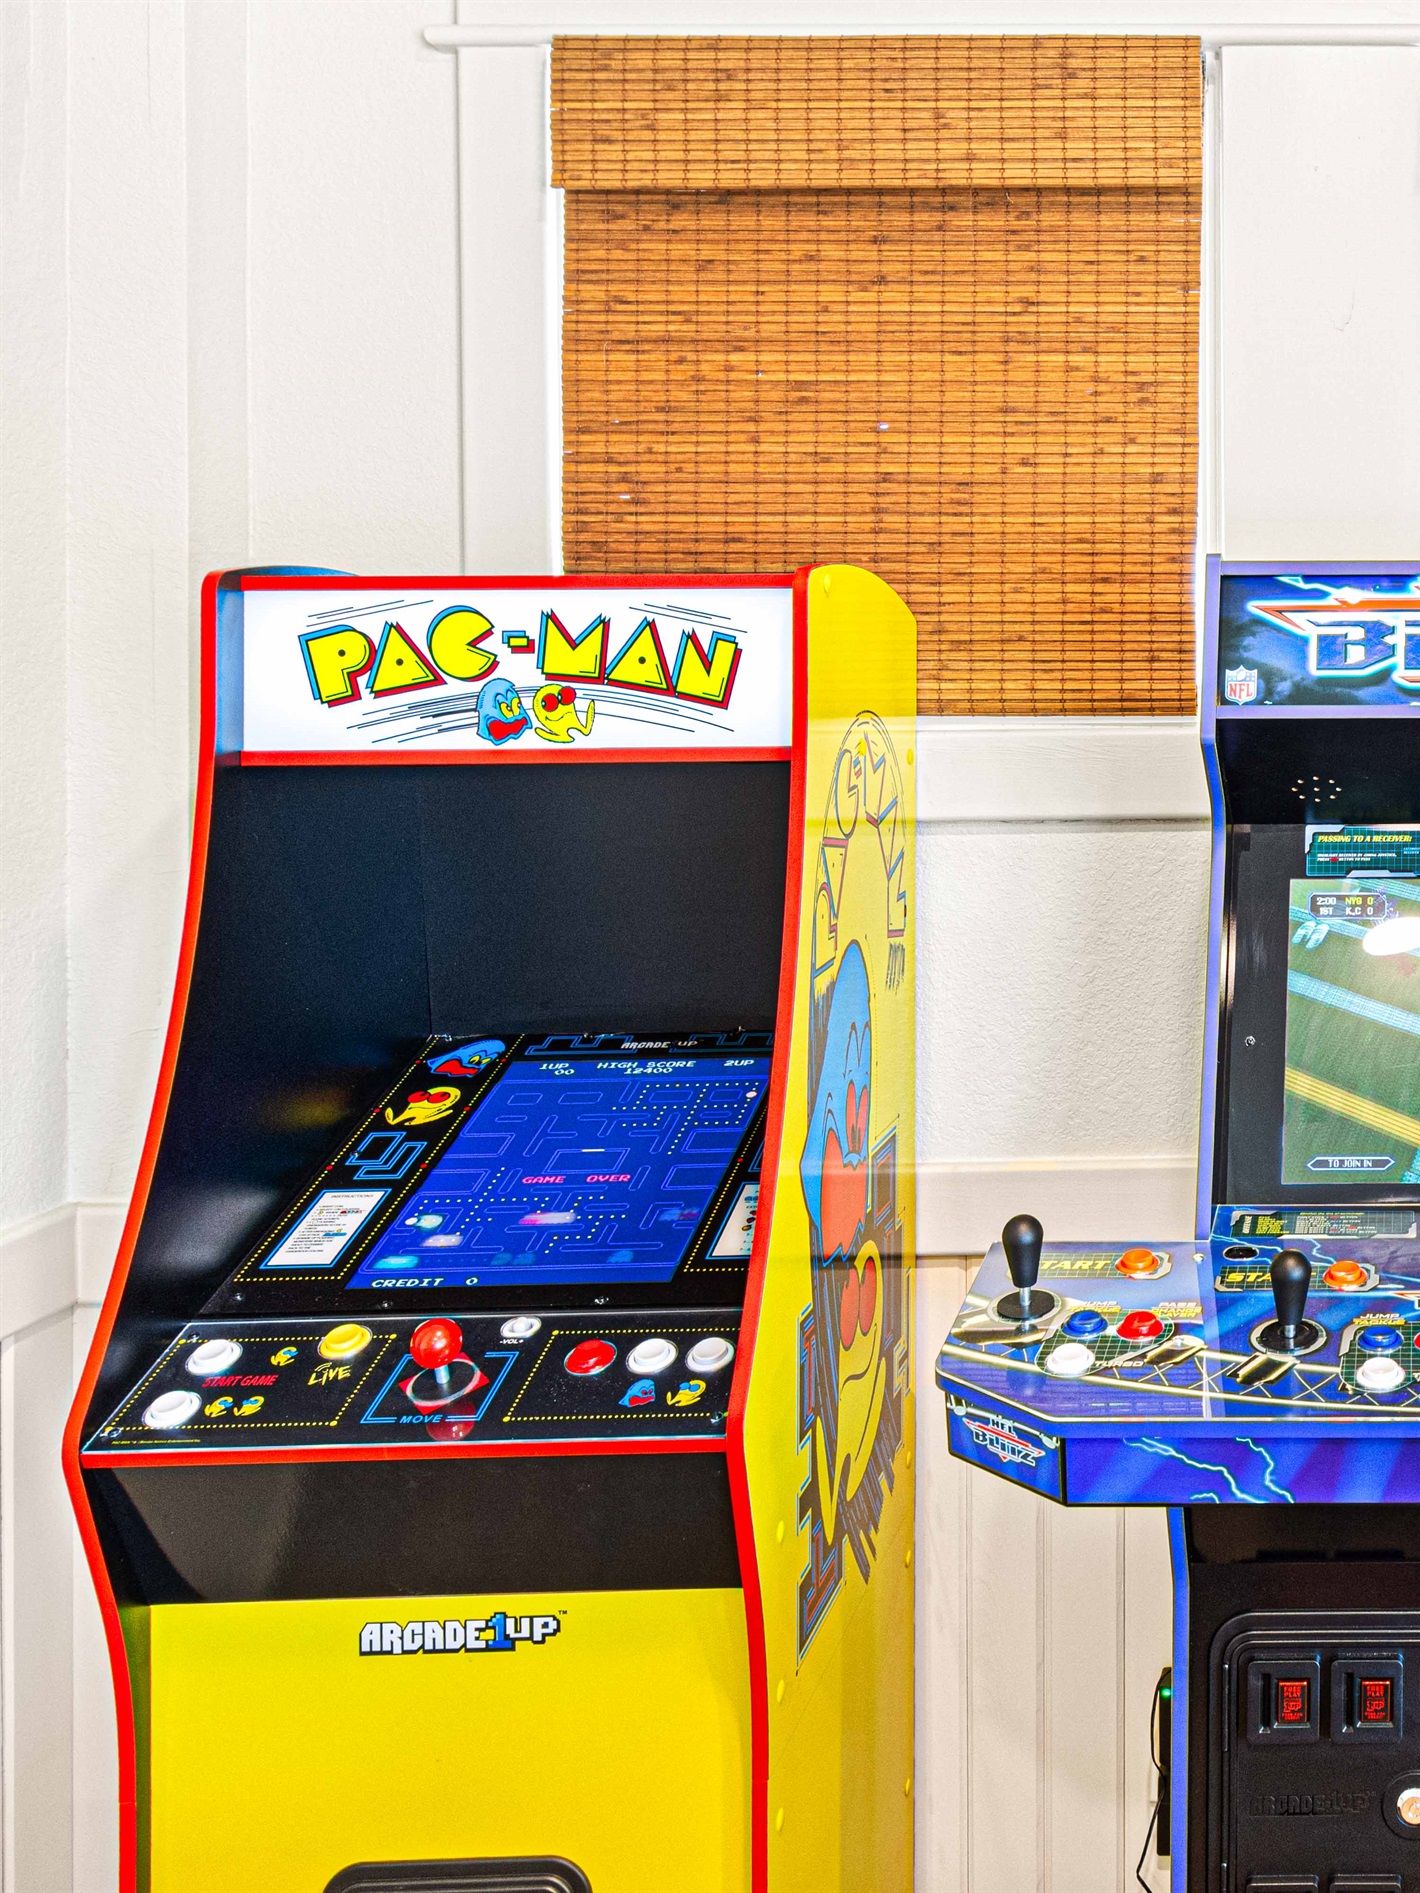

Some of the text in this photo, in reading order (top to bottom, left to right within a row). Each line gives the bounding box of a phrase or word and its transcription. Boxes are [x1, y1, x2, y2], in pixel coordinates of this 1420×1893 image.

[298, 605, 743, 709] PAC-MAN
[1228, 683, 1253, 700] NFL
[1316, 897, 1336, 905] 2:00
[1367, 897, 1374, 905] 0
[1320, 907, 1334, 915] 1ST
[1367, 907, 1374, 915] 0
[539, 1062, 569, 1070] 1UP
[646, 1060, 696, 1068] SCORE
[1328, 1159, 1372, 1168] TO JOIN IN
[522, 1174, 631, 1185] GAME OVER
[1041, 1260, 1110, 1270] TART
[371, 1276, 479, 1288] CREDIT 0
[308, 1364, 351, 1386] LIVE
[202, 1374, 278, 1388] START GAME
[400, 1414, 442, 1423] MOVE
[991, 1418, 1013, 1434] NFL
[974, 1430, 1036, 1467] BLITZ
